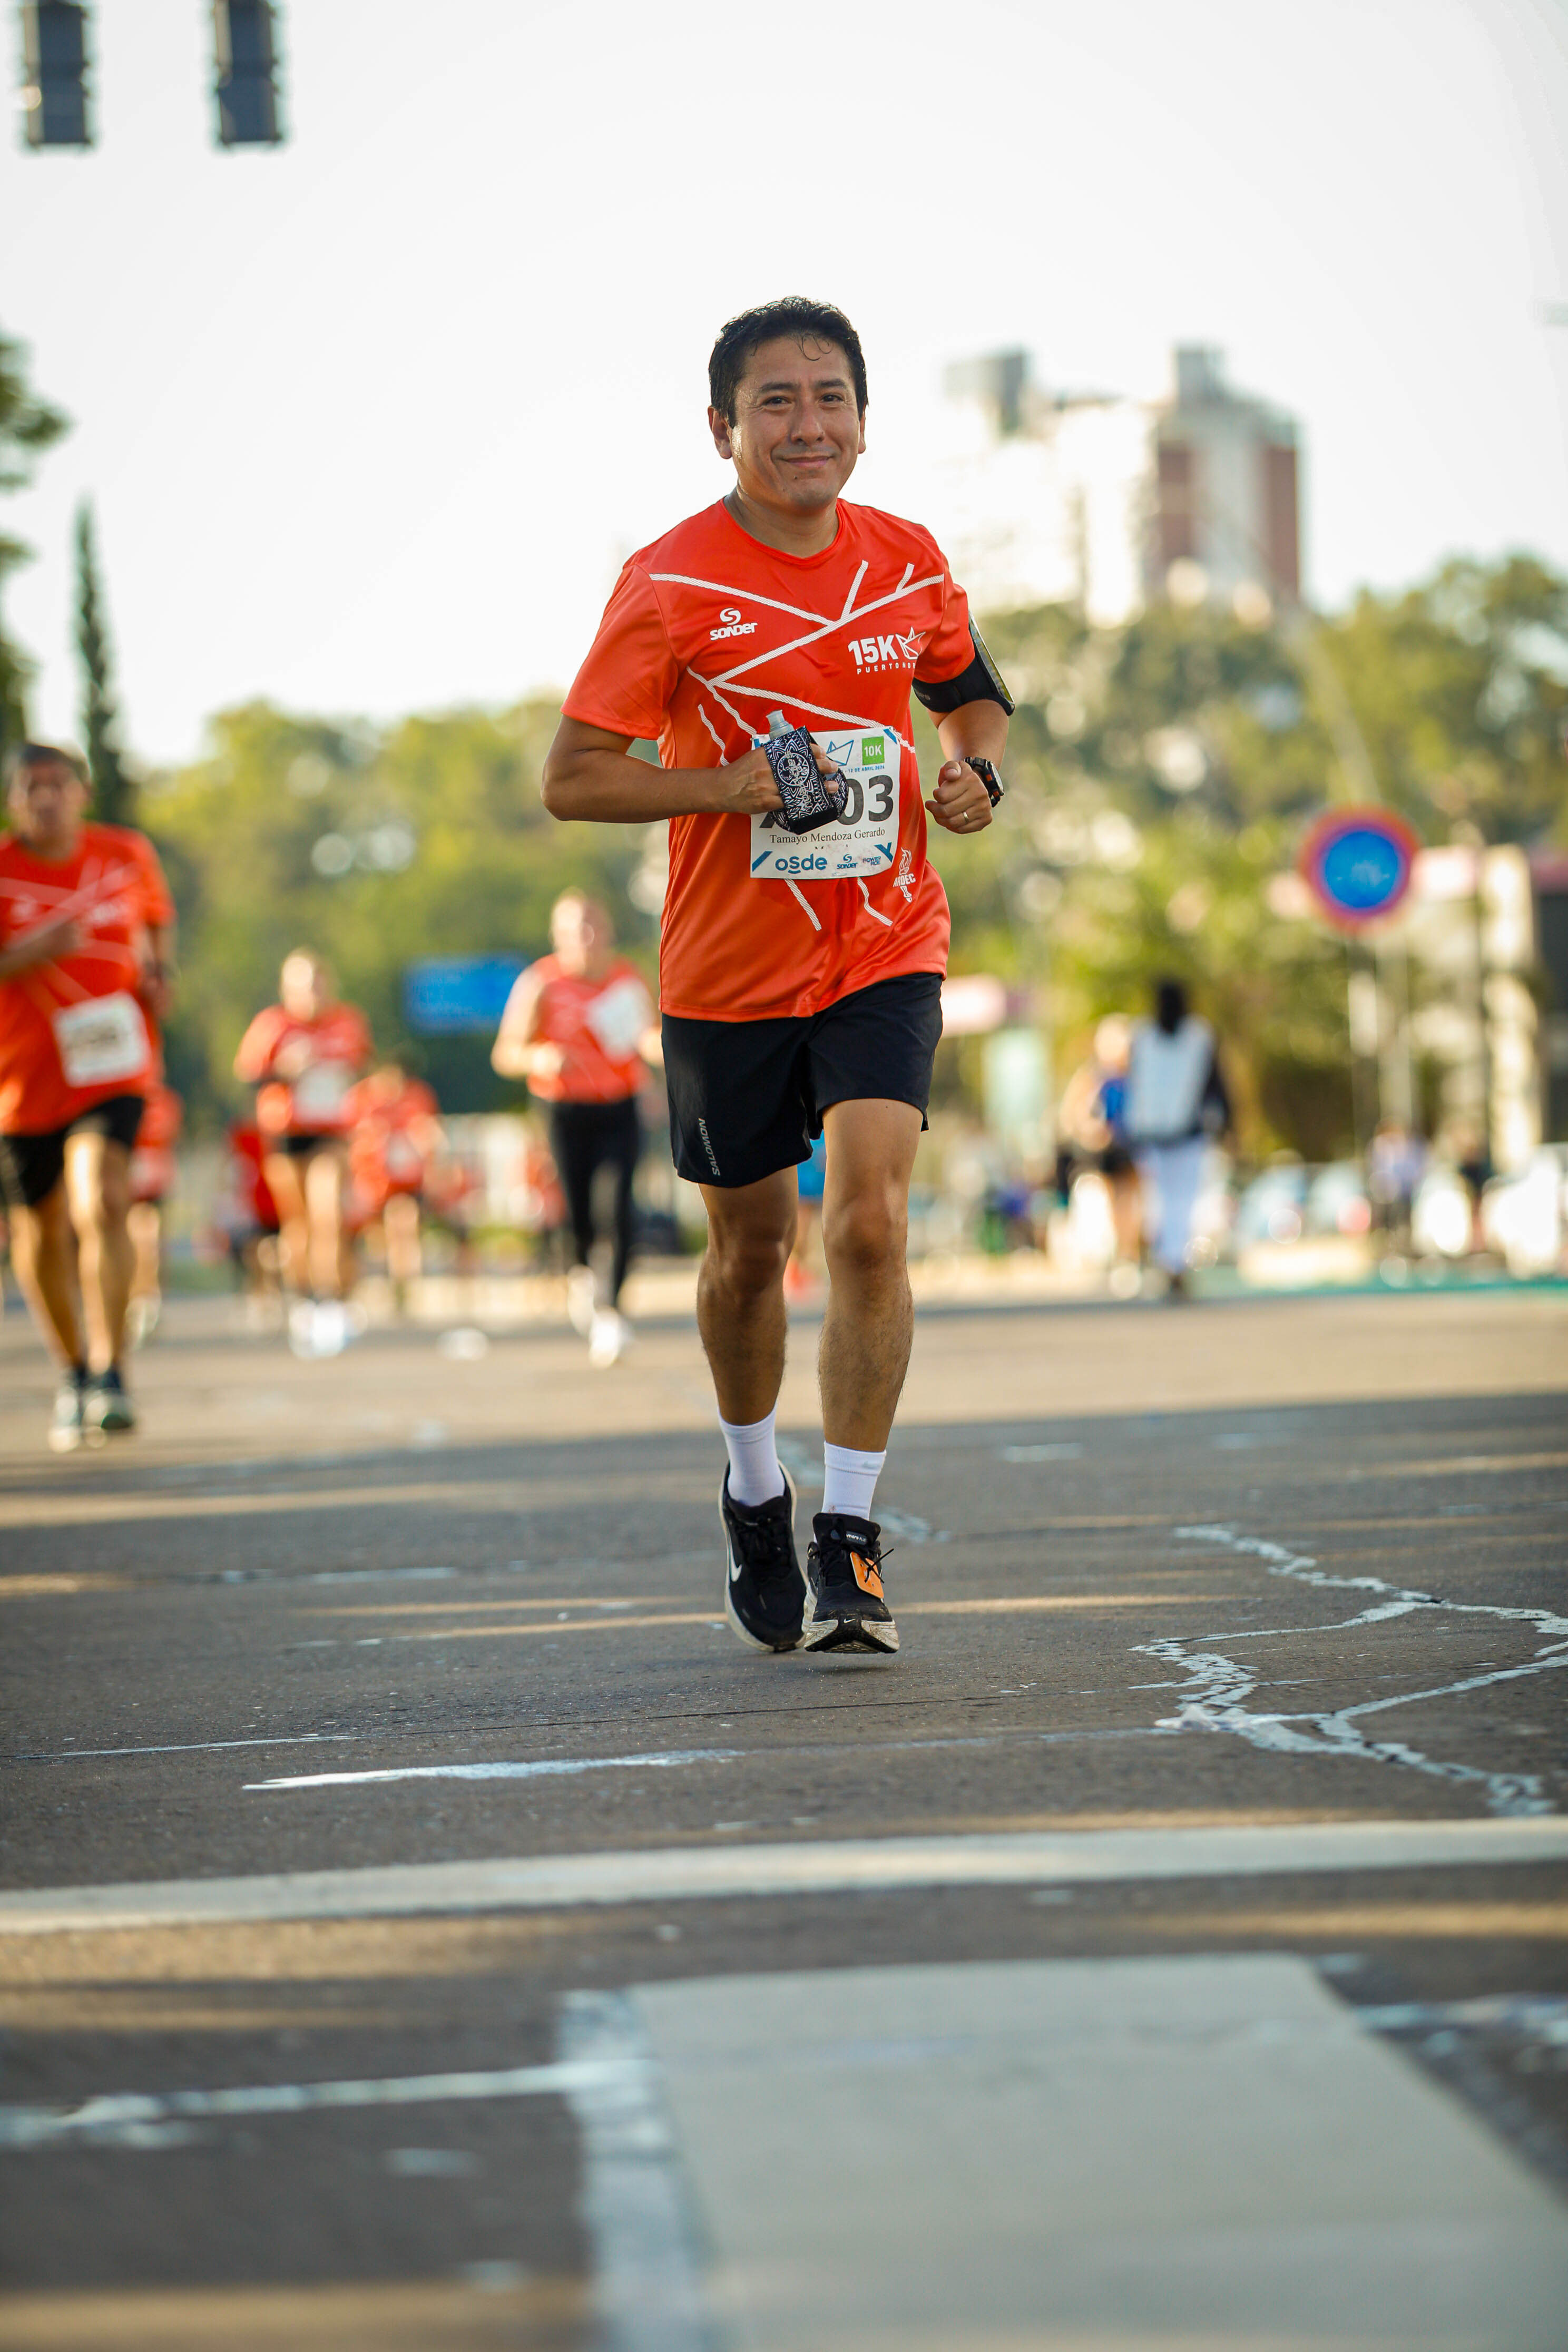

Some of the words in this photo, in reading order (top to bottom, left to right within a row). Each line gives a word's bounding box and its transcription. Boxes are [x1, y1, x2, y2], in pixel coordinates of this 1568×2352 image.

[848, 635, 898, 665] 15K
[864, 744, 882, 757] 10K
[769, 834, 808, 845] Tamayo
[811, 832, 852, 841] Mendoza
[854, 827, 885, 838] Gerardo
[775, 853, 828, 871] osde
[893, 873, 916, 887] ARDEC
[698, 1117, 720, 1176] SALOMON
